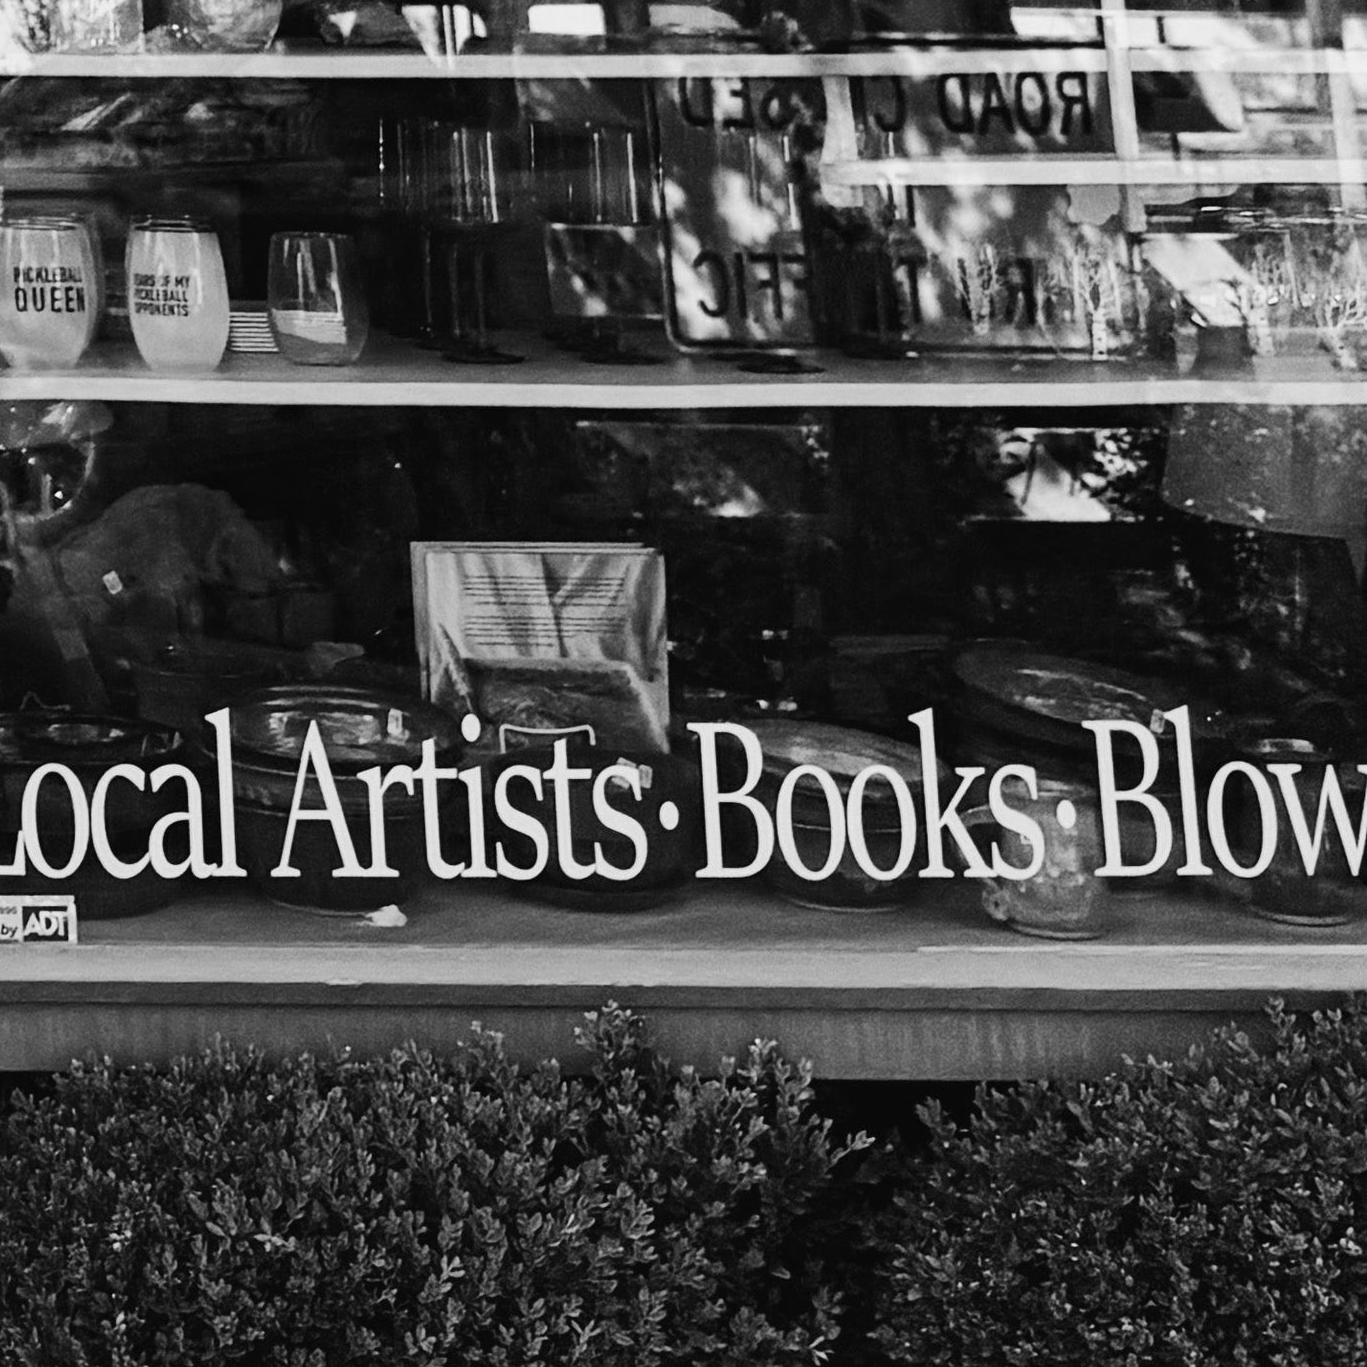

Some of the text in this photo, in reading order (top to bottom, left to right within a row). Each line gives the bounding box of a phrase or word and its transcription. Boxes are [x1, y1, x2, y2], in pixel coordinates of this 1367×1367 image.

[174, 274, 191, 288] MY
[14, 285, 86, 313] QUEEN
[0, 924, 18, 938] by
[24, 910, 68, 936] ADT
